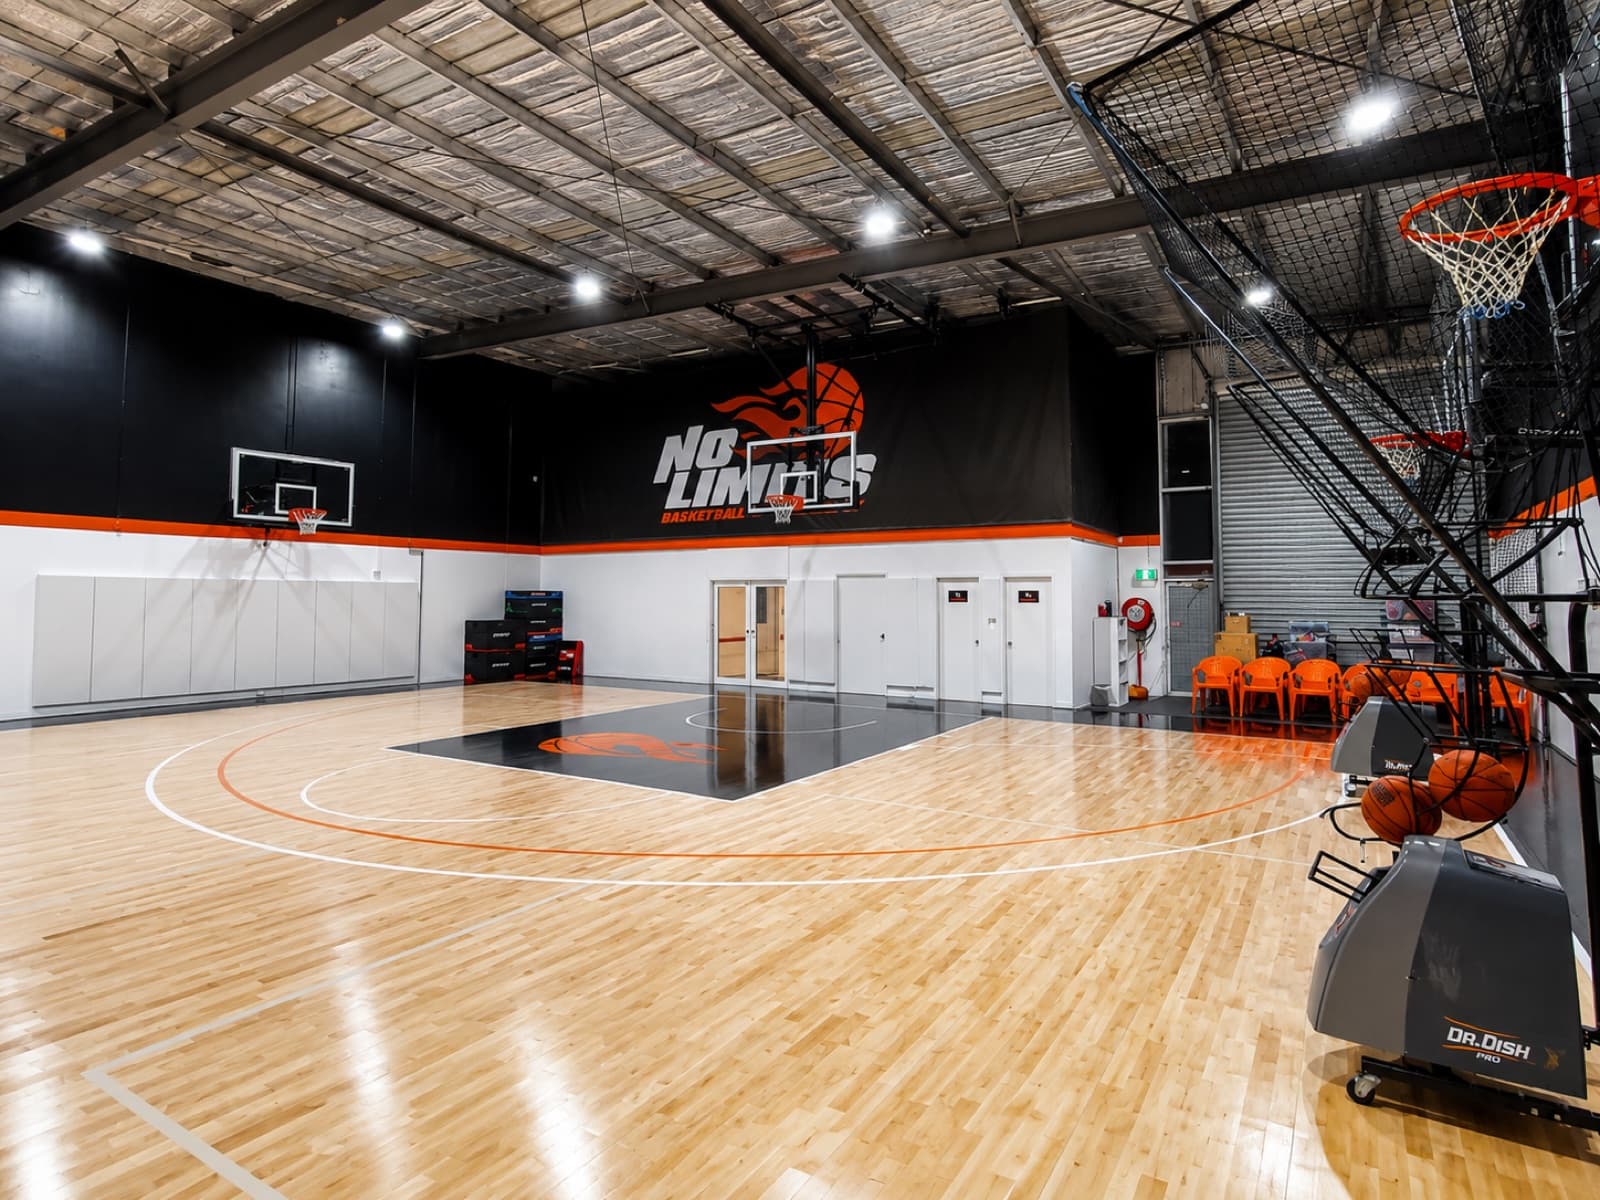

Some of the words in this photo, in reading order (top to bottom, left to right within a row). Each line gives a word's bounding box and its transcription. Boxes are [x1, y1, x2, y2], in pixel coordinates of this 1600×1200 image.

[653, 425, 739, 484] NO
[661, 507, 745, 524] BASKETBALL
[1476, 1052, 1501, 1064] PRO
